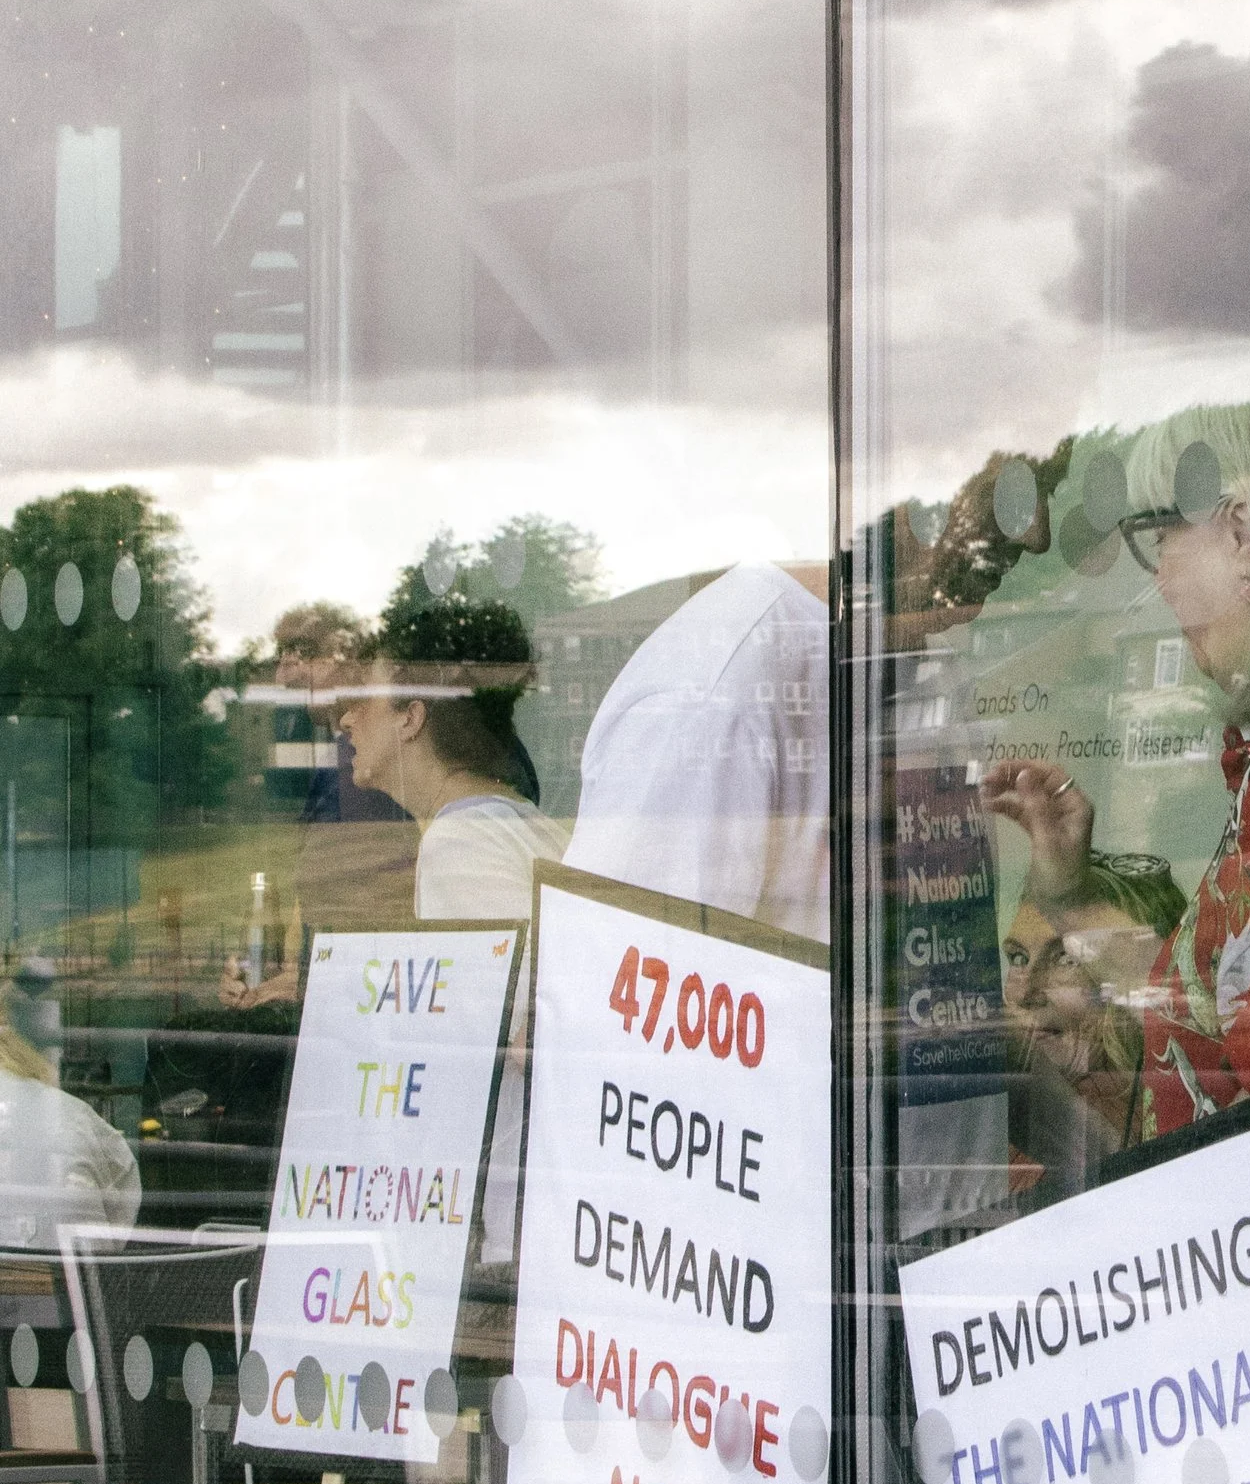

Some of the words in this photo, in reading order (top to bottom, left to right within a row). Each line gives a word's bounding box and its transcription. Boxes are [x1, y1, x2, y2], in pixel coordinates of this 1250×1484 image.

[1023, 683, 1048, 712] On
[1057, 729, 1125, 760] Practice,
[966, 797, 988, 839] th
[907, 859, 989, 907] National
[904, 925, 966, 966] Glass
[357, 957, 454, 1014] SAVE
[609, 945, 765, 1069] 47,000
[908, 988, 988, 1028] Centre
[356, 1062, 427, 1118] THE
[600, 1081, 764, 1203] PEOPLE
[281, 1162, 464, 1225] NATIONAL
[574, 1199, 775, 1333] DEMAND
[303, 1267, 417, 1328] GLASS
[271, 1369, 416, 1435] CNTE
